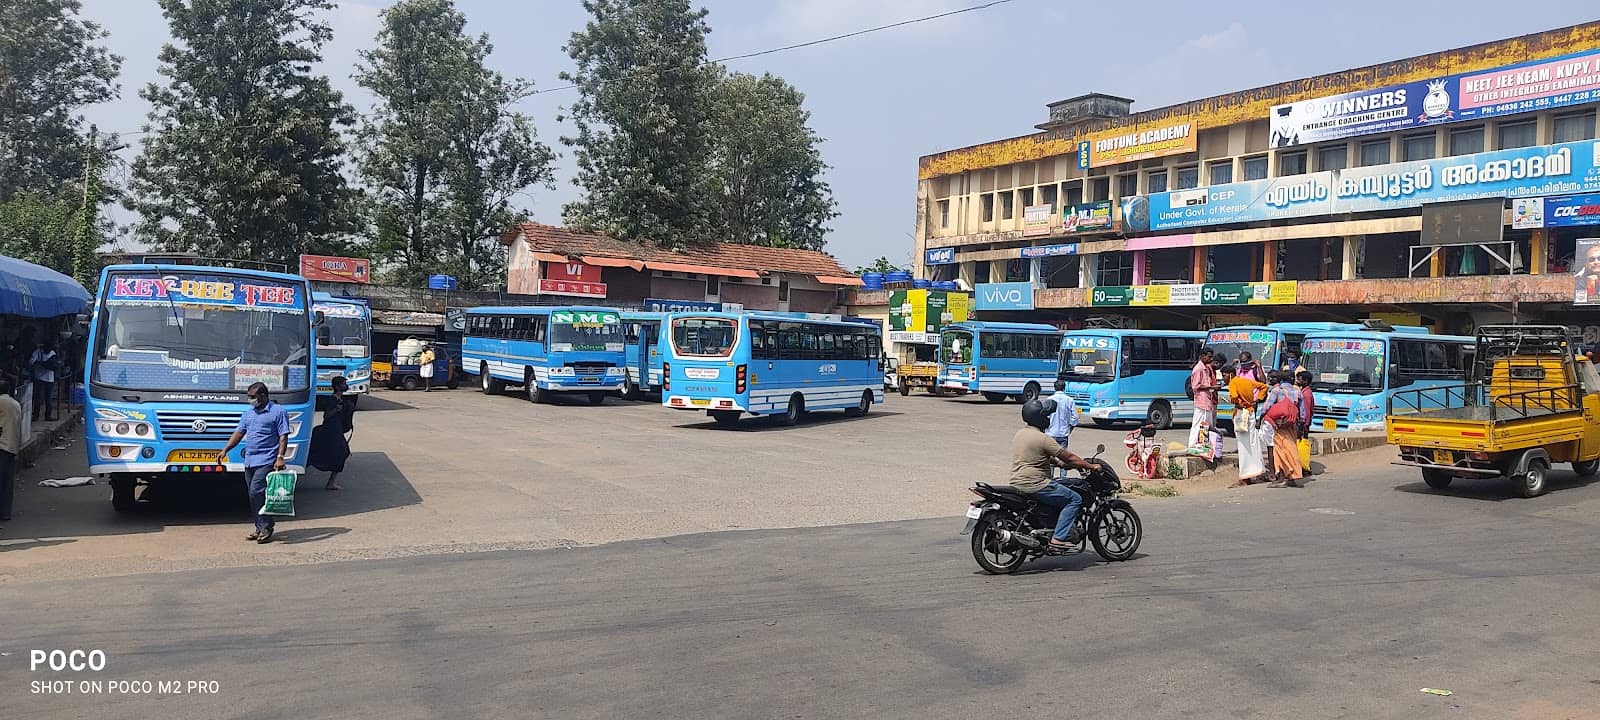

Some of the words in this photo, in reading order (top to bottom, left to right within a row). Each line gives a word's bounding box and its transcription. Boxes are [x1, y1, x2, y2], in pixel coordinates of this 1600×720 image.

[1466, 80, 1493, 94] NEET,
[1496, 77, 1514, 90] JEE
[1516, 68, 1553, 87] KEAM,
[1556, 61, 1592, 80] KVPY,
[1321, 89, 1408, 118] WINNERS
[1473, 92, 1498, 103] OTHER
[1500, 85, 1550, 99] INTEGRATED
[1519, 99, 1533, 109] 242
[1302, 120, 1337, 132] ENTRANCE
[1338, 113, 1376, 127] COACHING
[1377, 108, 1406, 120] CENTRE
[1096, 133, 1139, 152] FORTUNE
[1140, 124, 1191, 146] ACADEMY
[1442, 147, 1572, 188] അക്കാദമി
[1160, 210, 1183, 220] Under
[1185, 207, 1206, 218] Govt.
[1209, 206, 1218, 215] of
[1220, 203, 1249, 214] Kerala
[114, 278, 174, 298] KEY
[181, 280, 235, 301] BEE
[240, 284, 295, 306] TEE
[984, 286, 1022, 303] vivo
[1094, 290, 1106, 302] 50
[1203, 287, 1218, 302] 50
